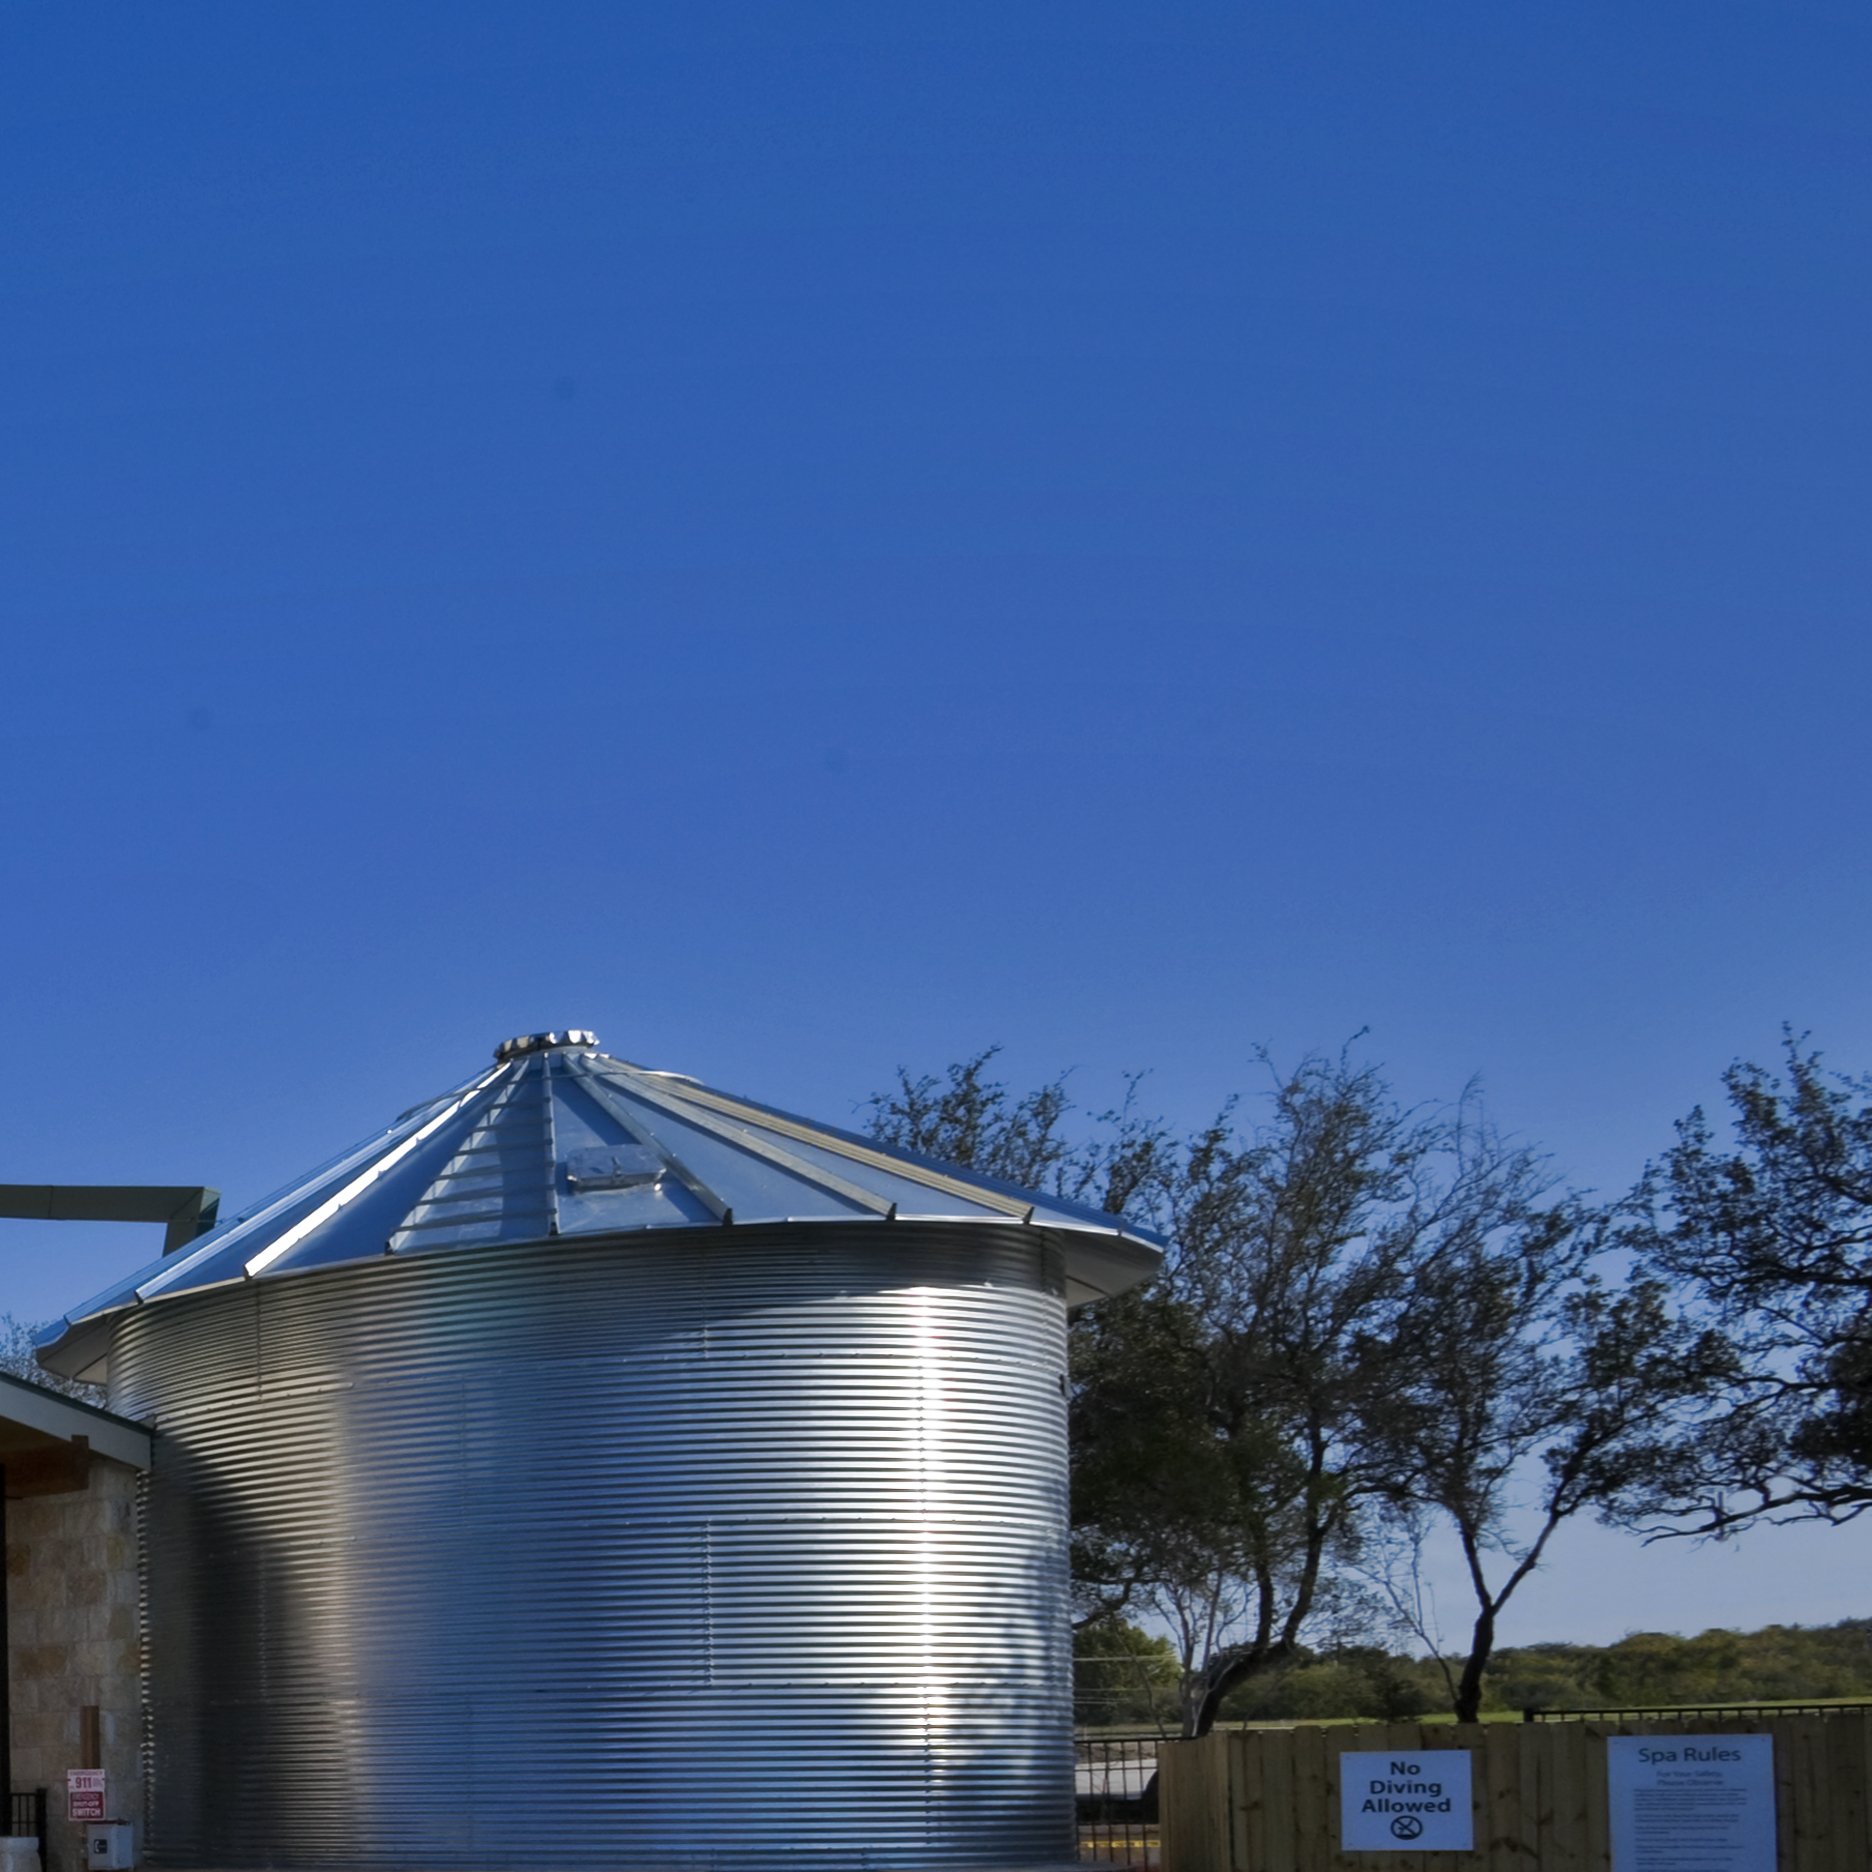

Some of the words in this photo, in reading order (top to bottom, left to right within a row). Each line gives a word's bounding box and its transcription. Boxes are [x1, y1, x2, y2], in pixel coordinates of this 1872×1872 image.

[1638, 1748, 1677, 1765] Spa
[1684, 1746, 1742, 1762] Rules
[1390, 1761, 1421, 1775] No
[75, 1777, 92, 1788] 911
[1370, 1780, 1441, 1797] Diving
[71, 1808, 101, 1817] SWITCH
[1360, 1798, 1451, 1813] Allowed
